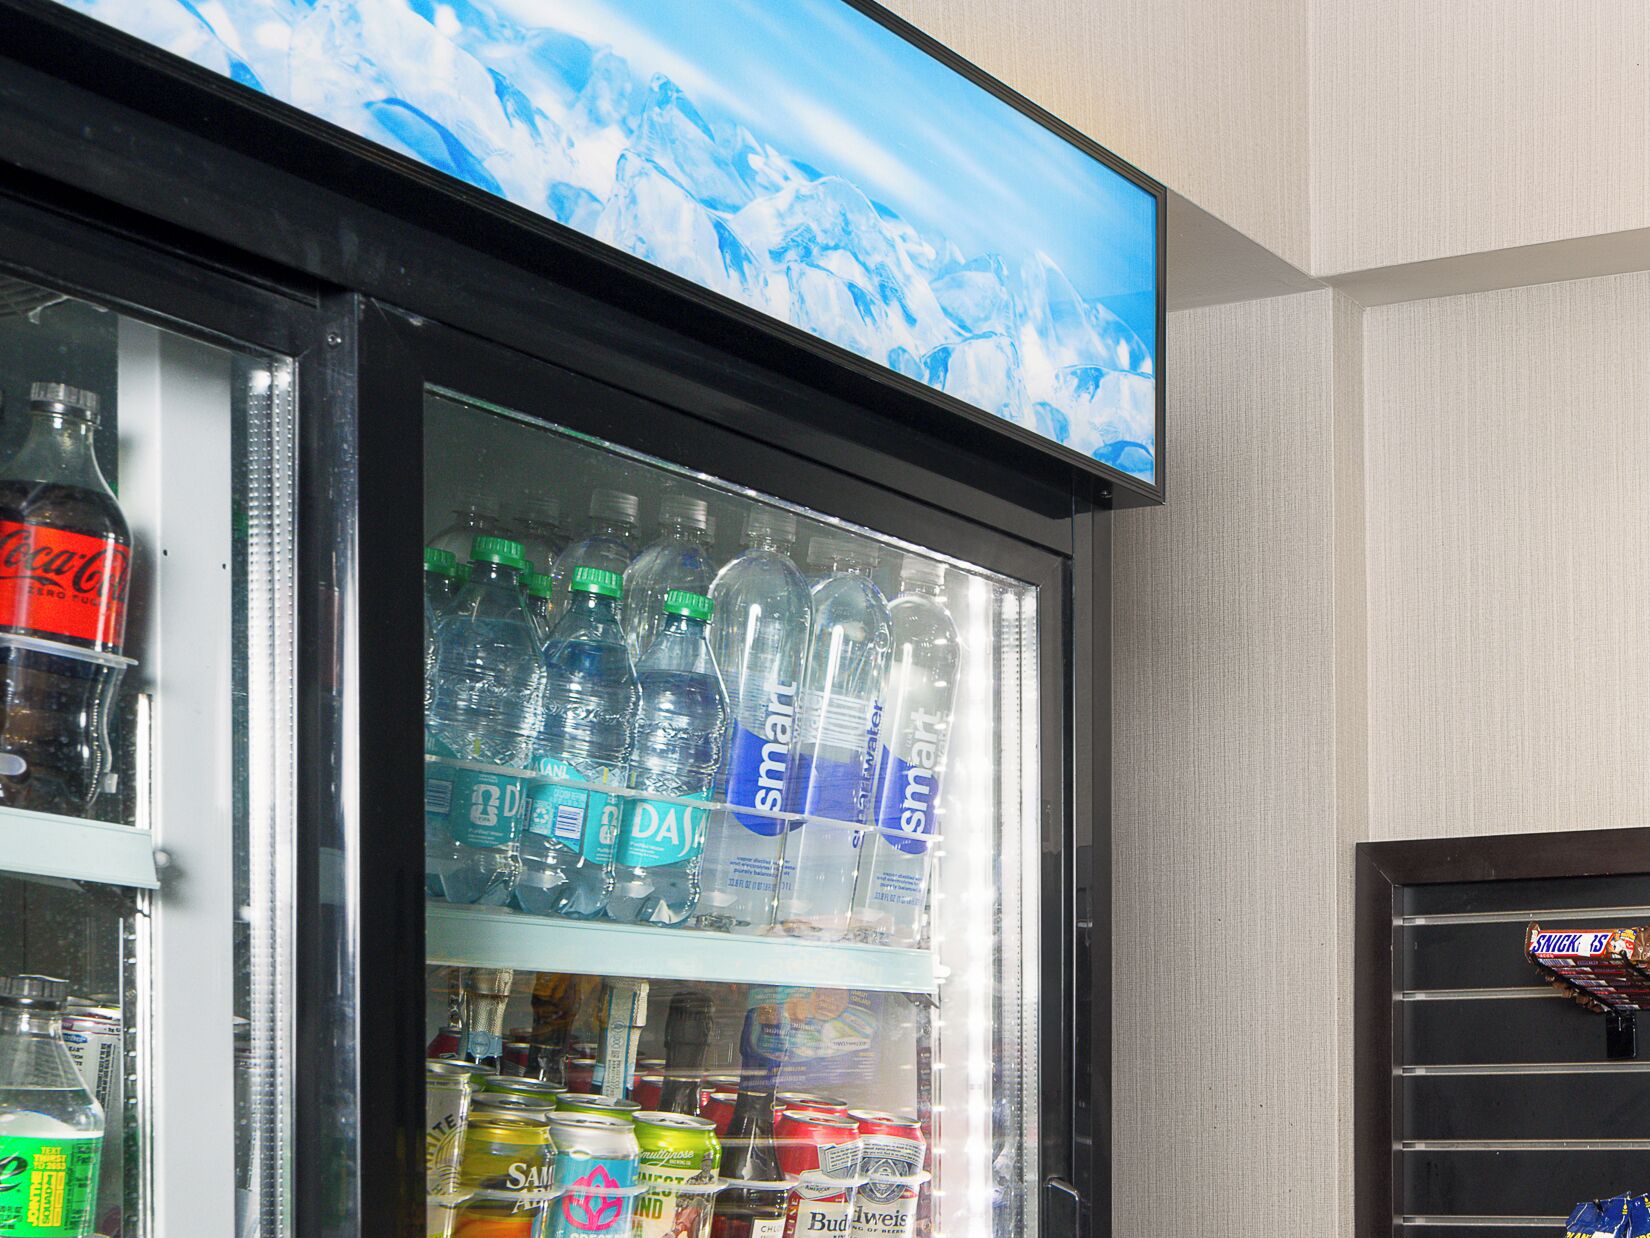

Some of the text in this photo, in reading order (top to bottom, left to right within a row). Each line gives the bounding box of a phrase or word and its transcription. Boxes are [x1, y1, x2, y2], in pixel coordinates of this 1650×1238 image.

[27, 585, 66, 600] ZERO
[754, 681, 797, 813] smart
[900, 707, 942, 835] smart
